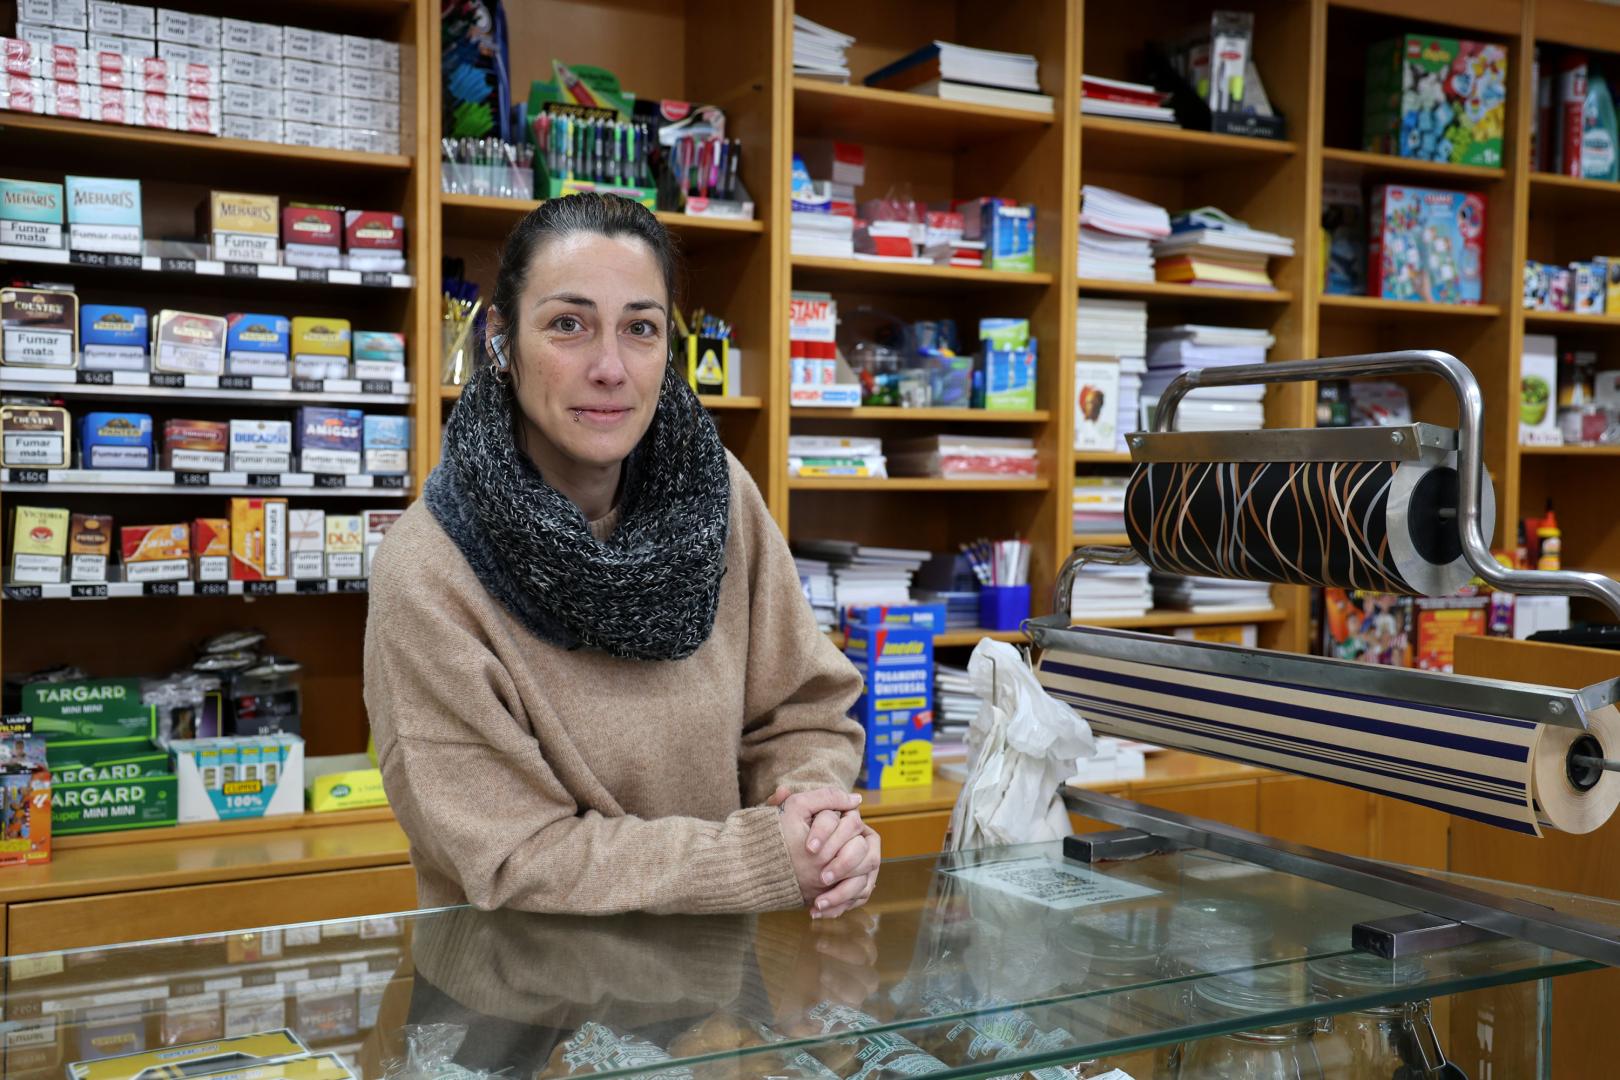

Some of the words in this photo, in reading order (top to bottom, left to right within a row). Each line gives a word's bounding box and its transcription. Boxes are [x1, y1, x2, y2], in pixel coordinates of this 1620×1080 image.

[11, 221, 49, 234] Fumar
[15, 232, 46, 241] mata
[224, 234, 268, 248] Fumar
[228, 249, 264, 259] mata
[18, 333, 59, 345] Fumar
[23, 345, 55, 356] mata
[306, 424, 358, 438] AMIGOS
[16, 438, 50, 448] Fumar
[20, 449, 47, 458] mata
[36, 685, 126, 703] TARGARD
[61, 705, 81, 715] MINI
[83, 704, 103, 713] MINI
[52, 764, 141, 783] ARGARD
[51, 786, 145, 807] ARGARD
[226, 795, 262, 808] 100%
[83, 807, 108, 819] MINI
[111, 805, 135, 816] MINI
